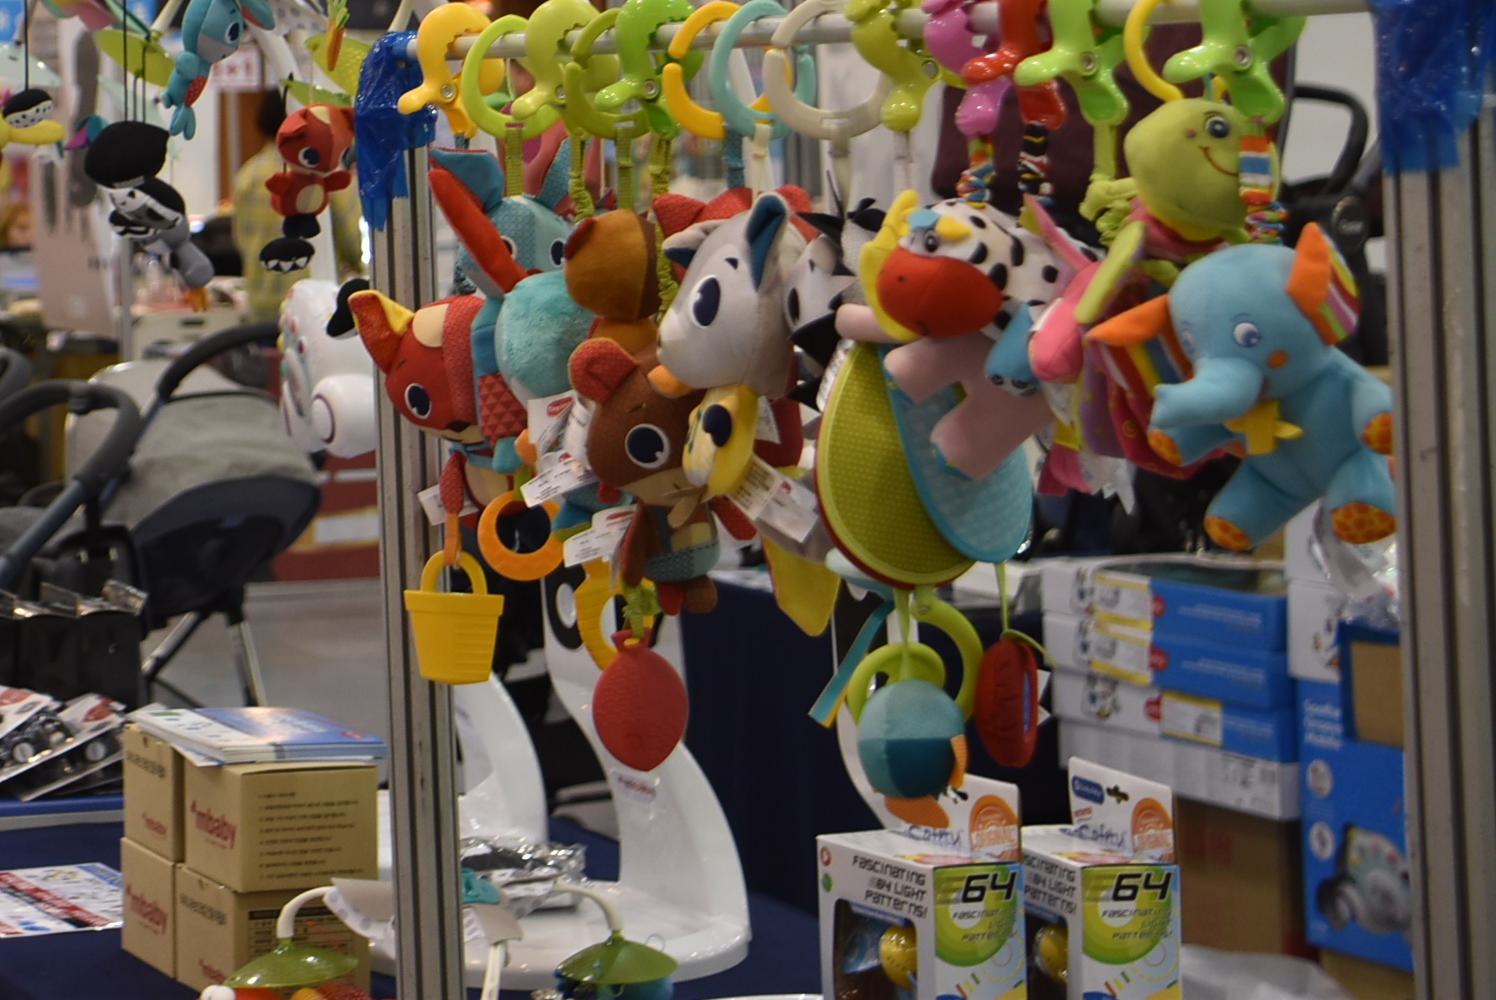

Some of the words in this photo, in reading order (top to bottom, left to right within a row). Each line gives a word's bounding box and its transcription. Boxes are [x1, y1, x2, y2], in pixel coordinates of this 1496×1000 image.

[894, 881, 927, 902] LIGHT
[962, 872, 1017, 903] 64
[1111, 872, 1172, 902] 64
